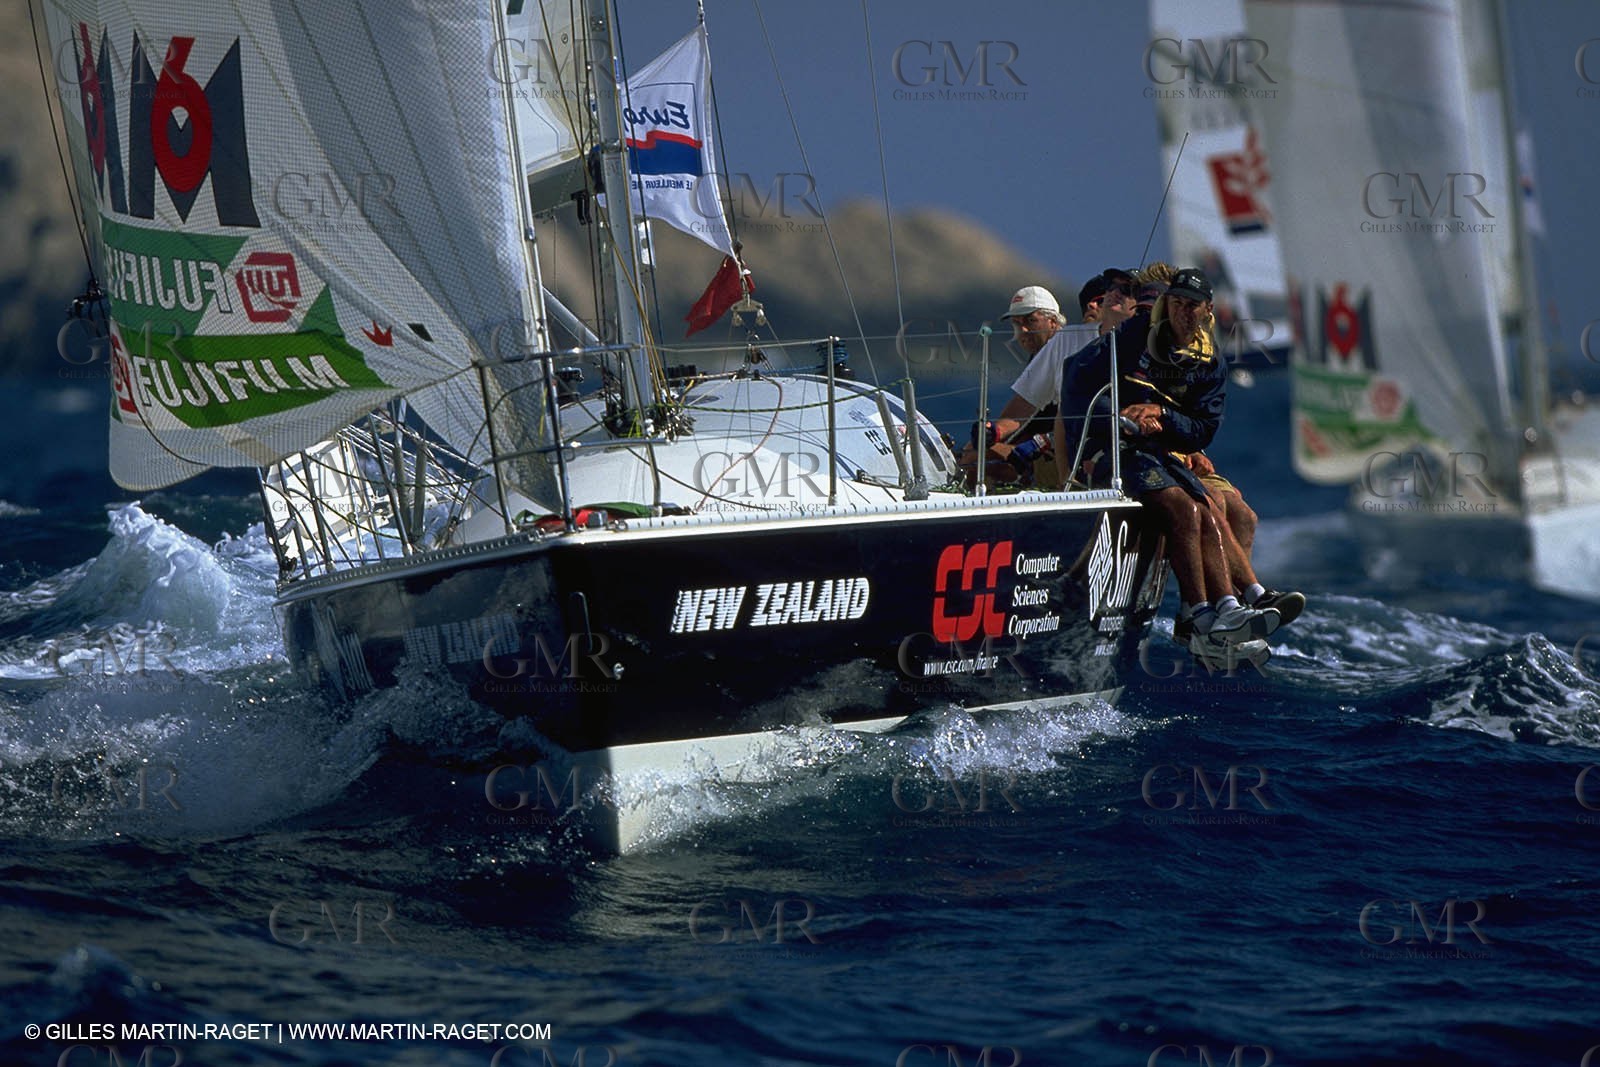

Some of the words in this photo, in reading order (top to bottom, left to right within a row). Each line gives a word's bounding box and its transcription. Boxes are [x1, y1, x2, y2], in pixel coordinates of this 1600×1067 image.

[132, 354, 351, 407] FUJIFILM
[1015, 553, 1060, 579] Computer
[670, 586, 747, 634] NEW
[749, 577, 870, 627] ZEALAND
[932, 540, 1014, 643] CSC
[1012, 584, 1050, 608] Sciences
[1008, 610, 1060, 640] Corporation
